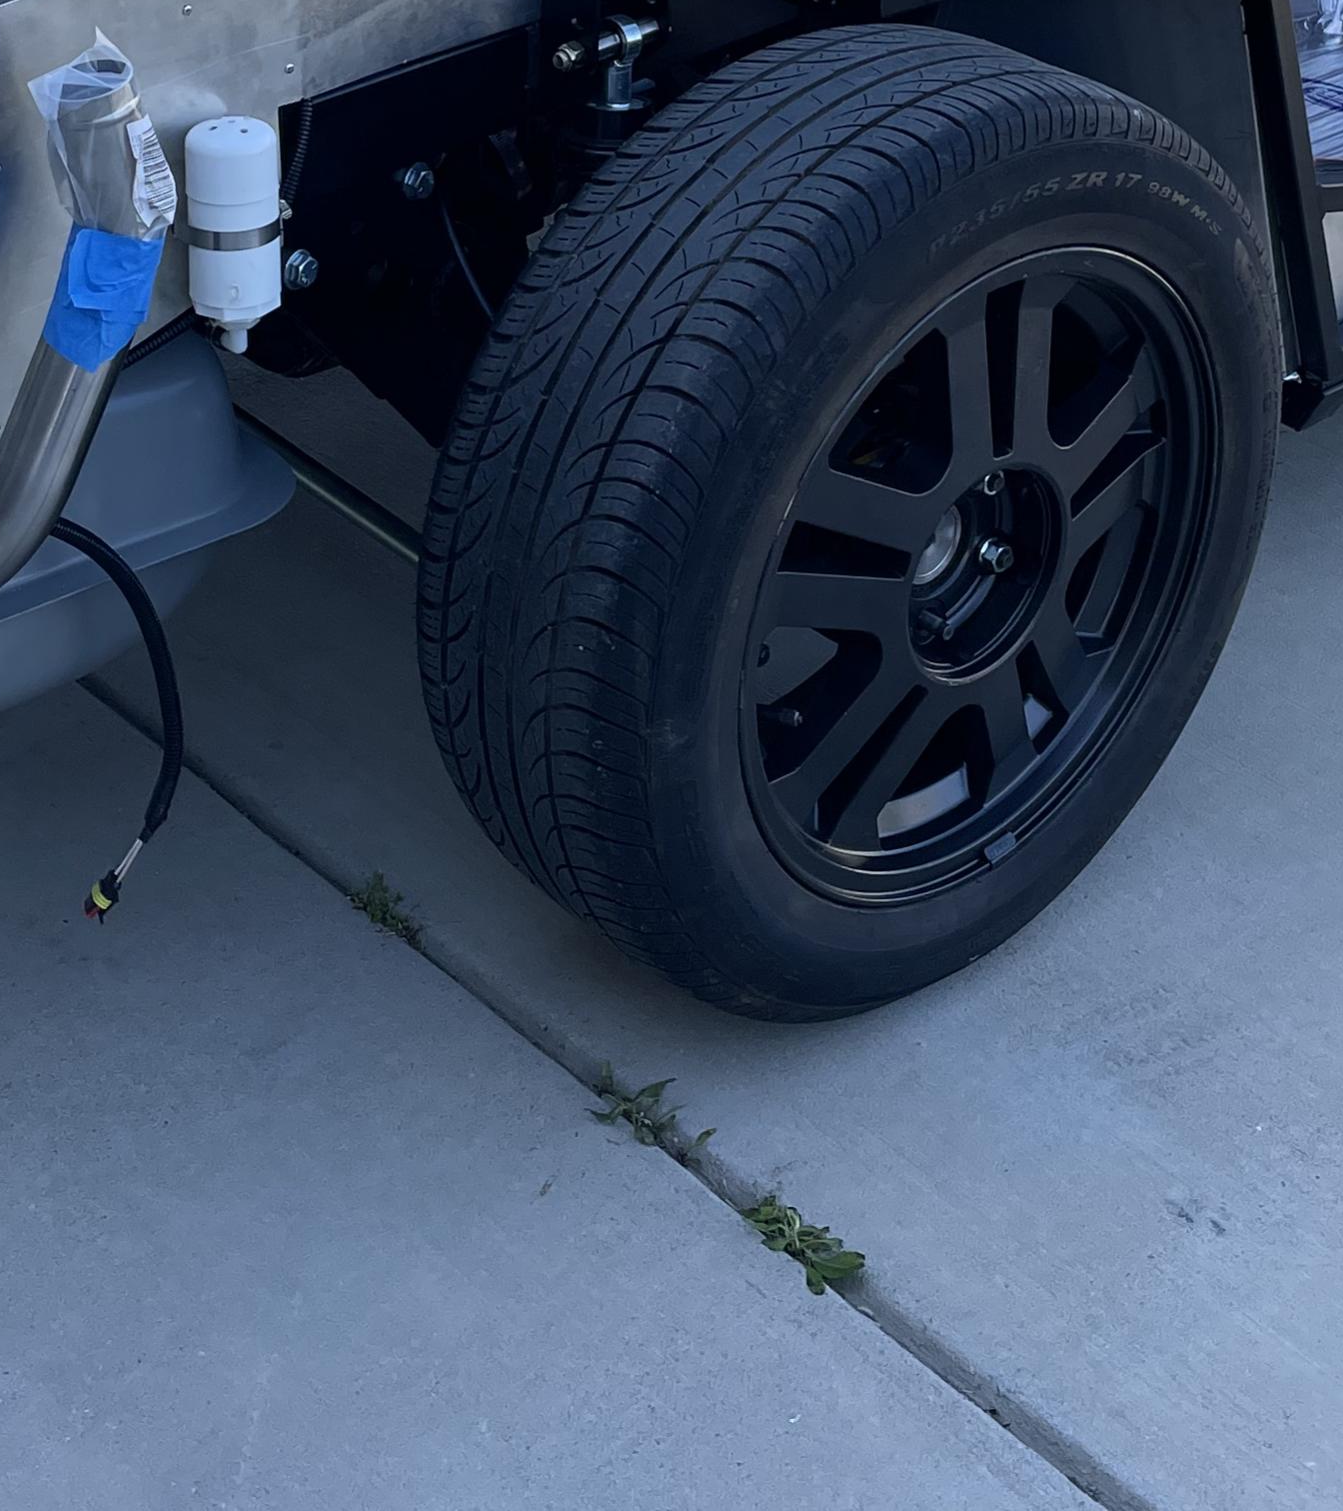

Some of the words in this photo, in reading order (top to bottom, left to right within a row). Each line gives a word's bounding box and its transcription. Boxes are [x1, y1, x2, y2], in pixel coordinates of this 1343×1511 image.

[1067, 170, 1108, 189] ZR
[1113, 171, 1143, 188] 17
[1147, 181, 1191, 207] 98W
